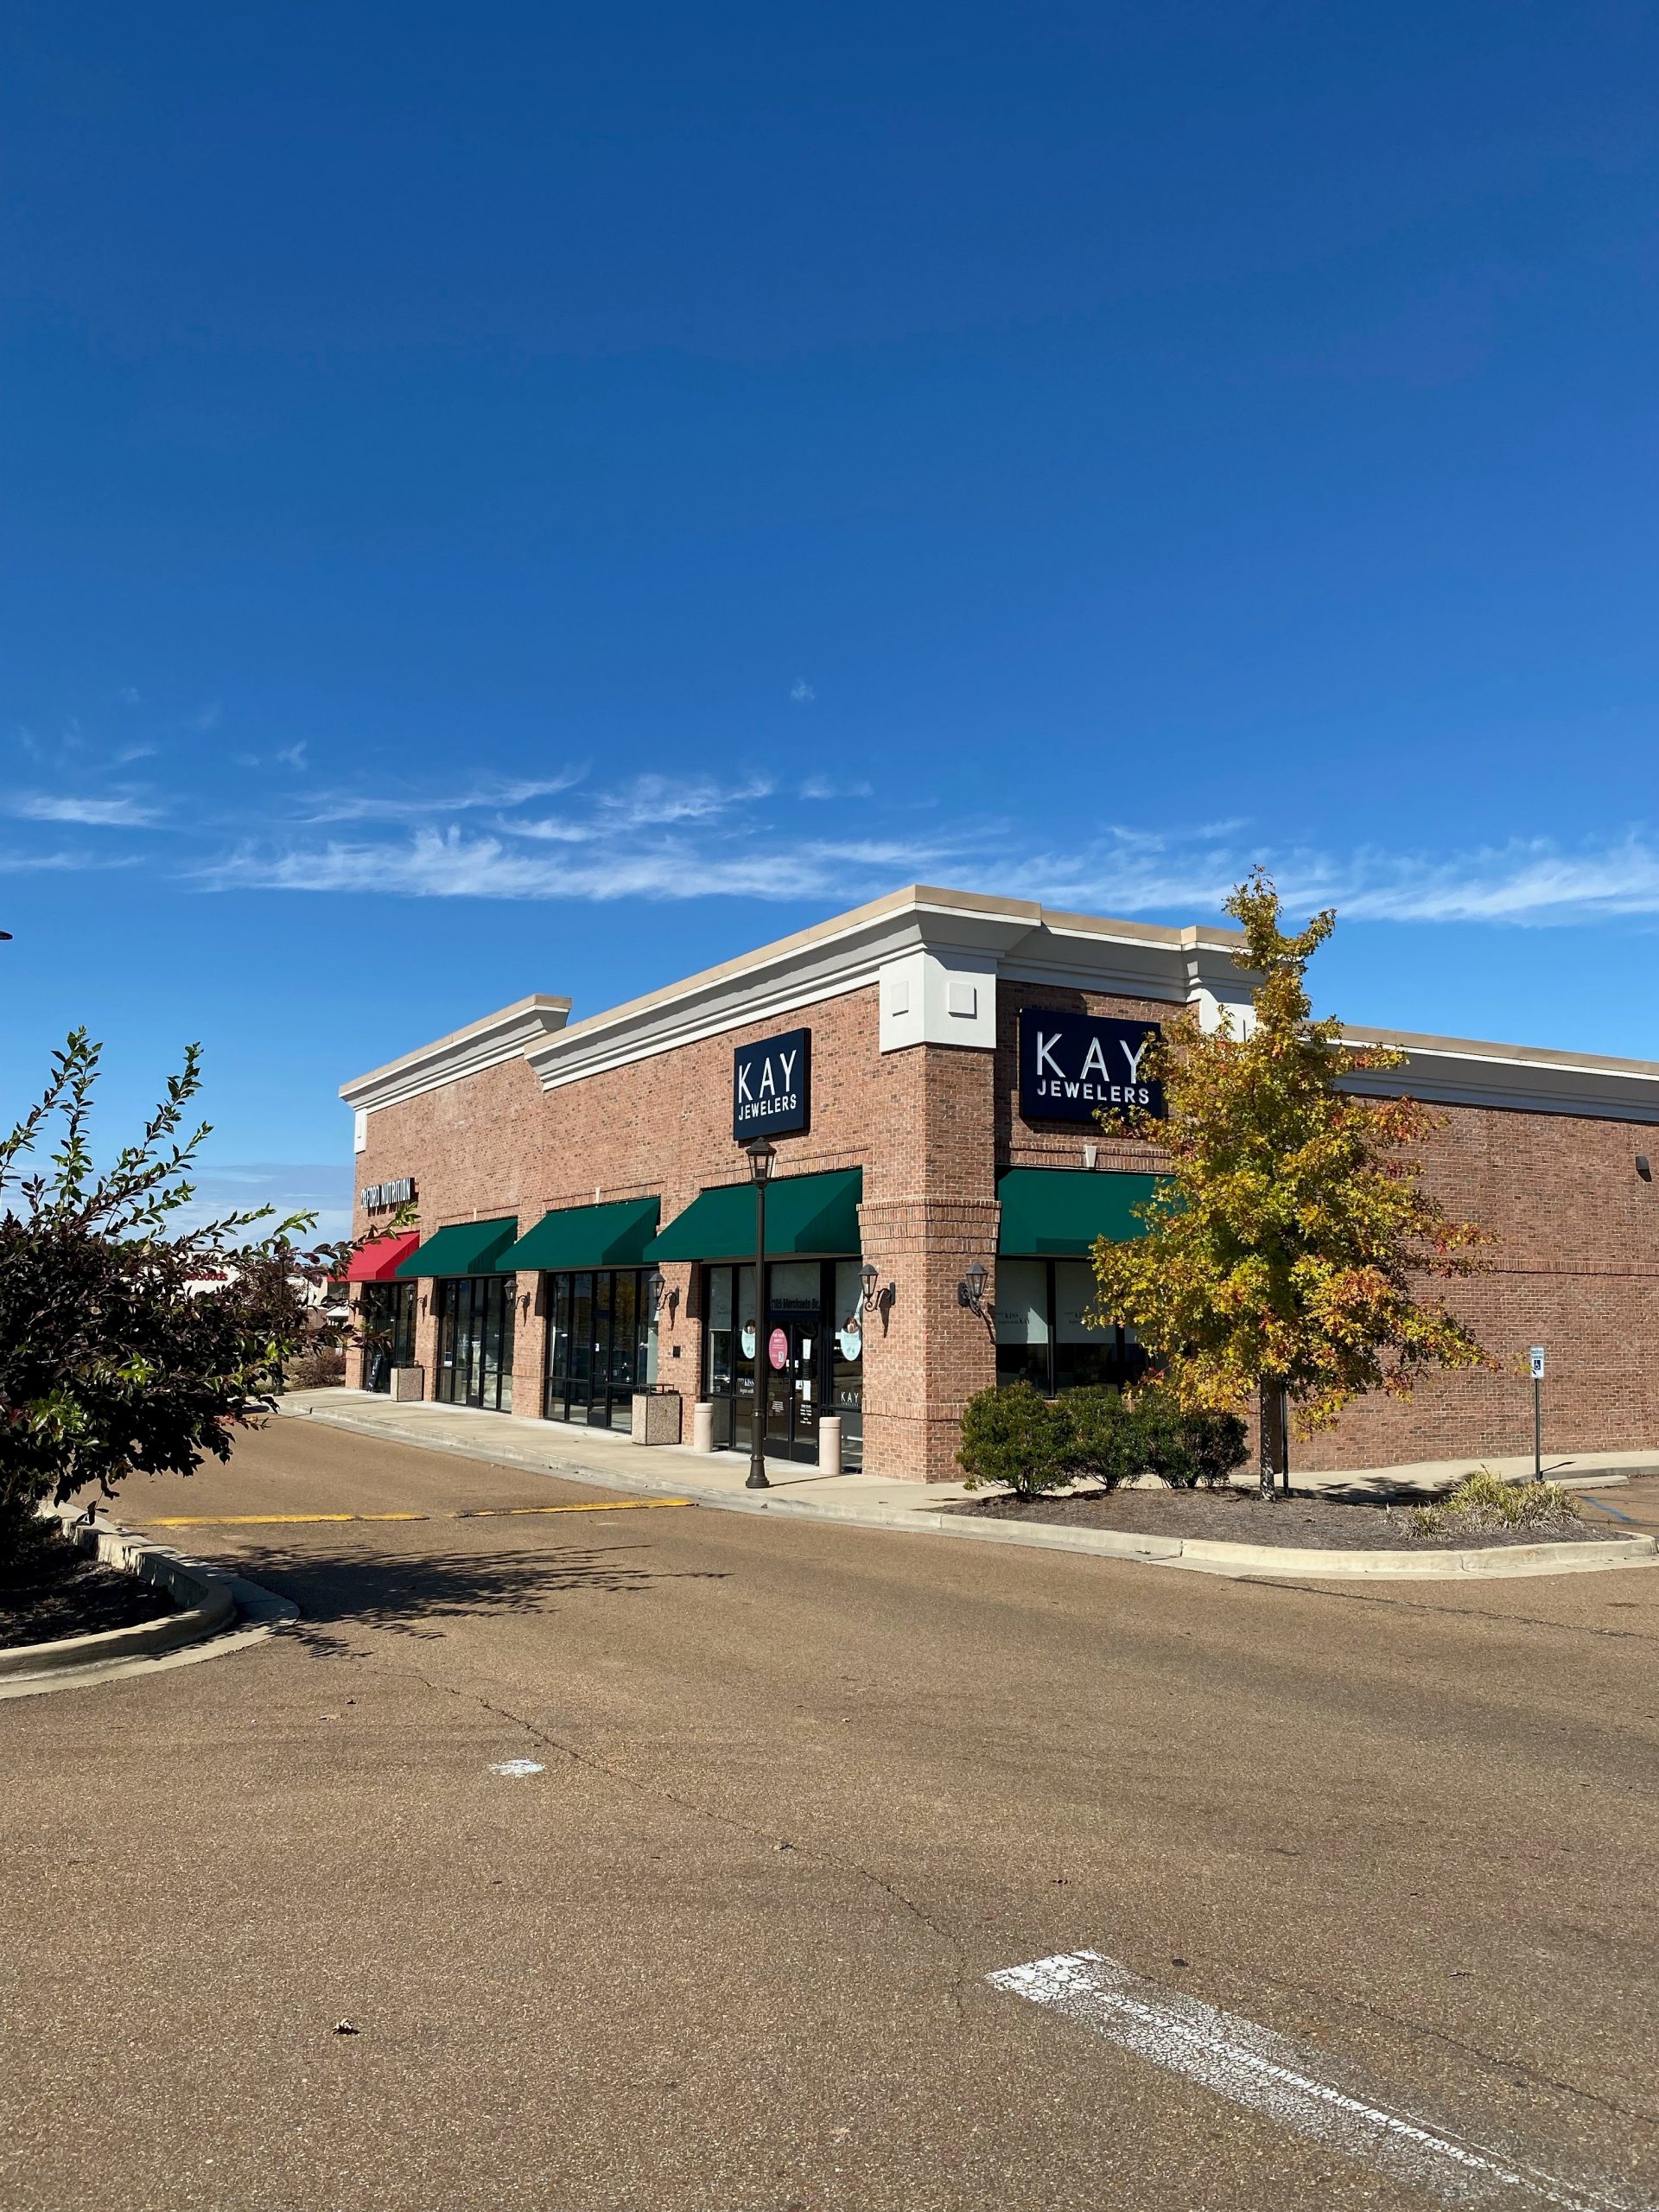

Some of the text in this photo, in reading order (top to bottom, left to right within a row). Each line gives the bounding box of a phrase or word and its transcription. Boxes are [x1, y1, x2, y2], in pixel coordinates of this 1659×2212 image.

[1036, 1031, 1148, 1084] KAY
[738, 1049, 797, 1104] KAY
[738, 1093, 798, 1121] JEWELERS
[1036, 1079, 1150, 1105] JEWELERS
[360, 1177, 411, 1210] OXFORD NUTRITION
[841, 1390, 859, 1403] KAY
